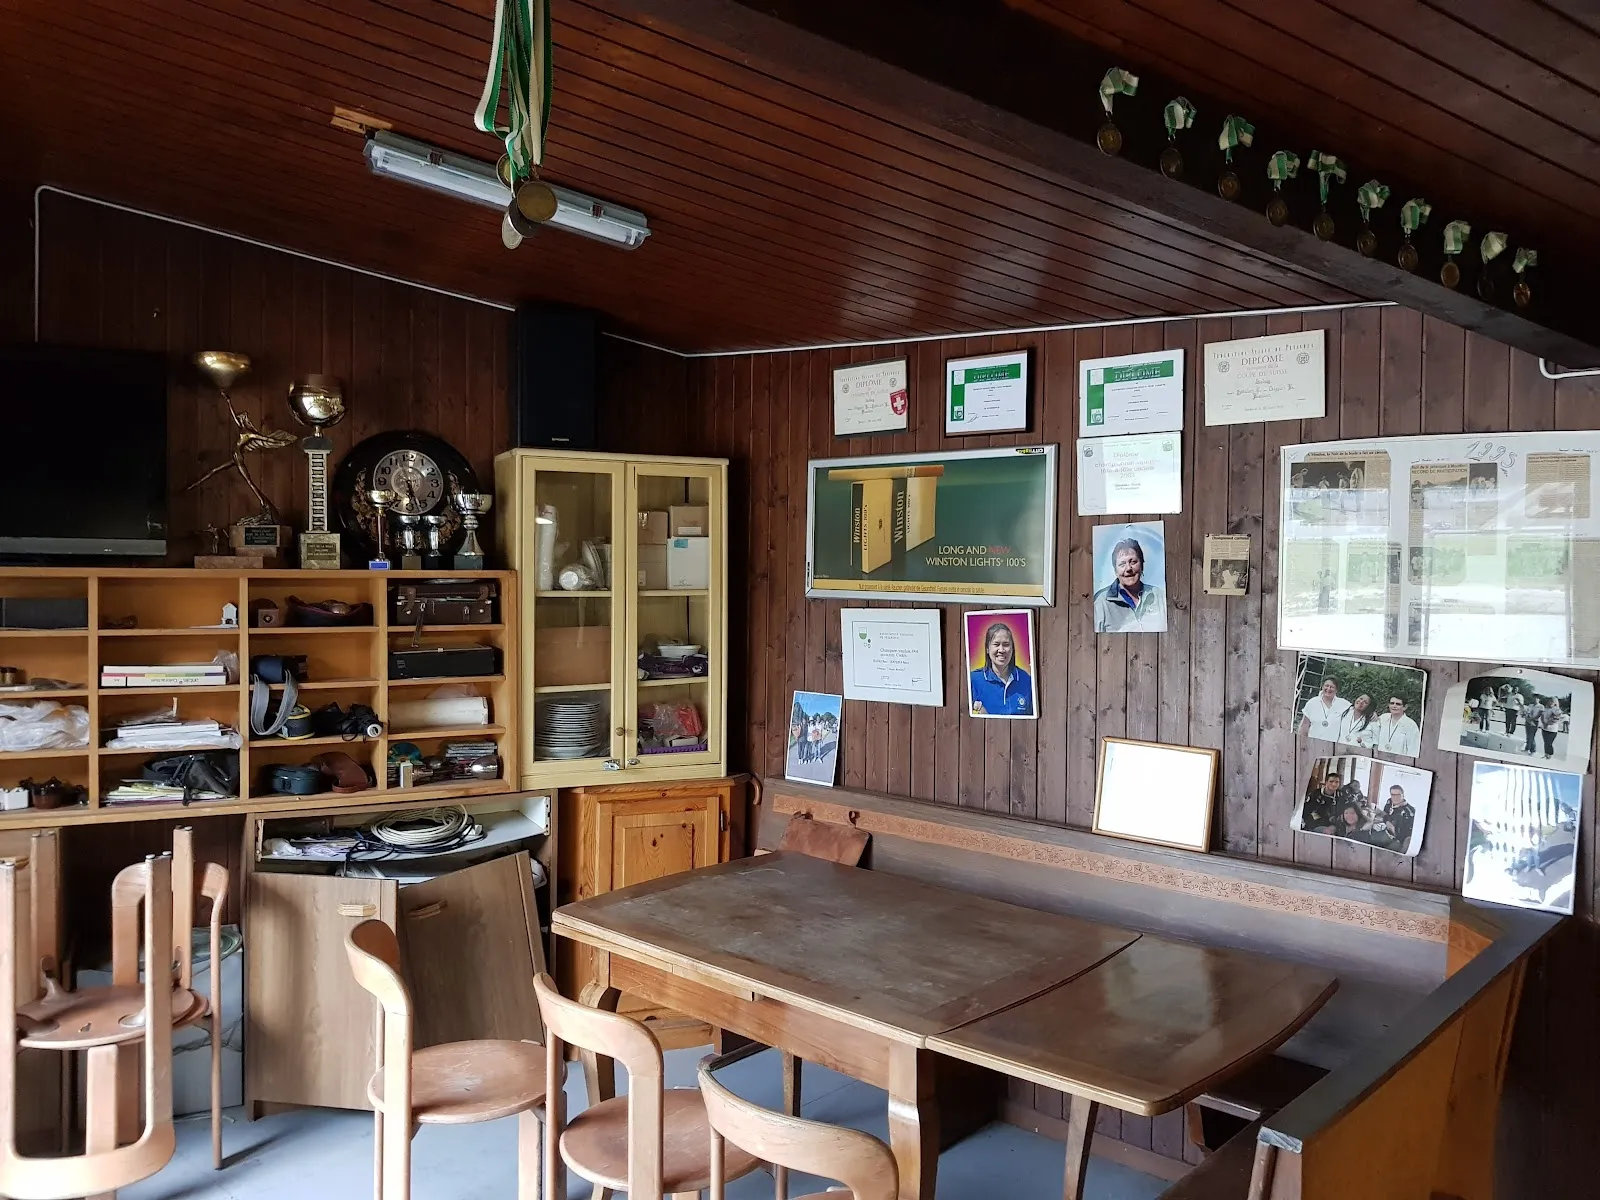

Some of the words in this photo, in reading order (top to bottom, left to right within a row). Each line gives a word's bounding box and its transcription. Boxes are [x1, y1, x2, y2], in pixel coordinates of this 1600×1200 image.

[381, 466, 391, 474] 10
[427, 467, 436, 476] 2
[378, 477, 386, 486] 9
[431, 479, 439, 488] 3
[894, 491, 904, 543] Winston
[938, 546, 964, 554] LONG
[966, 545, 987, 554] AND
[926, 557, 967, 567] WINSTON
[1006, 558, 1026, 567] 100'S
